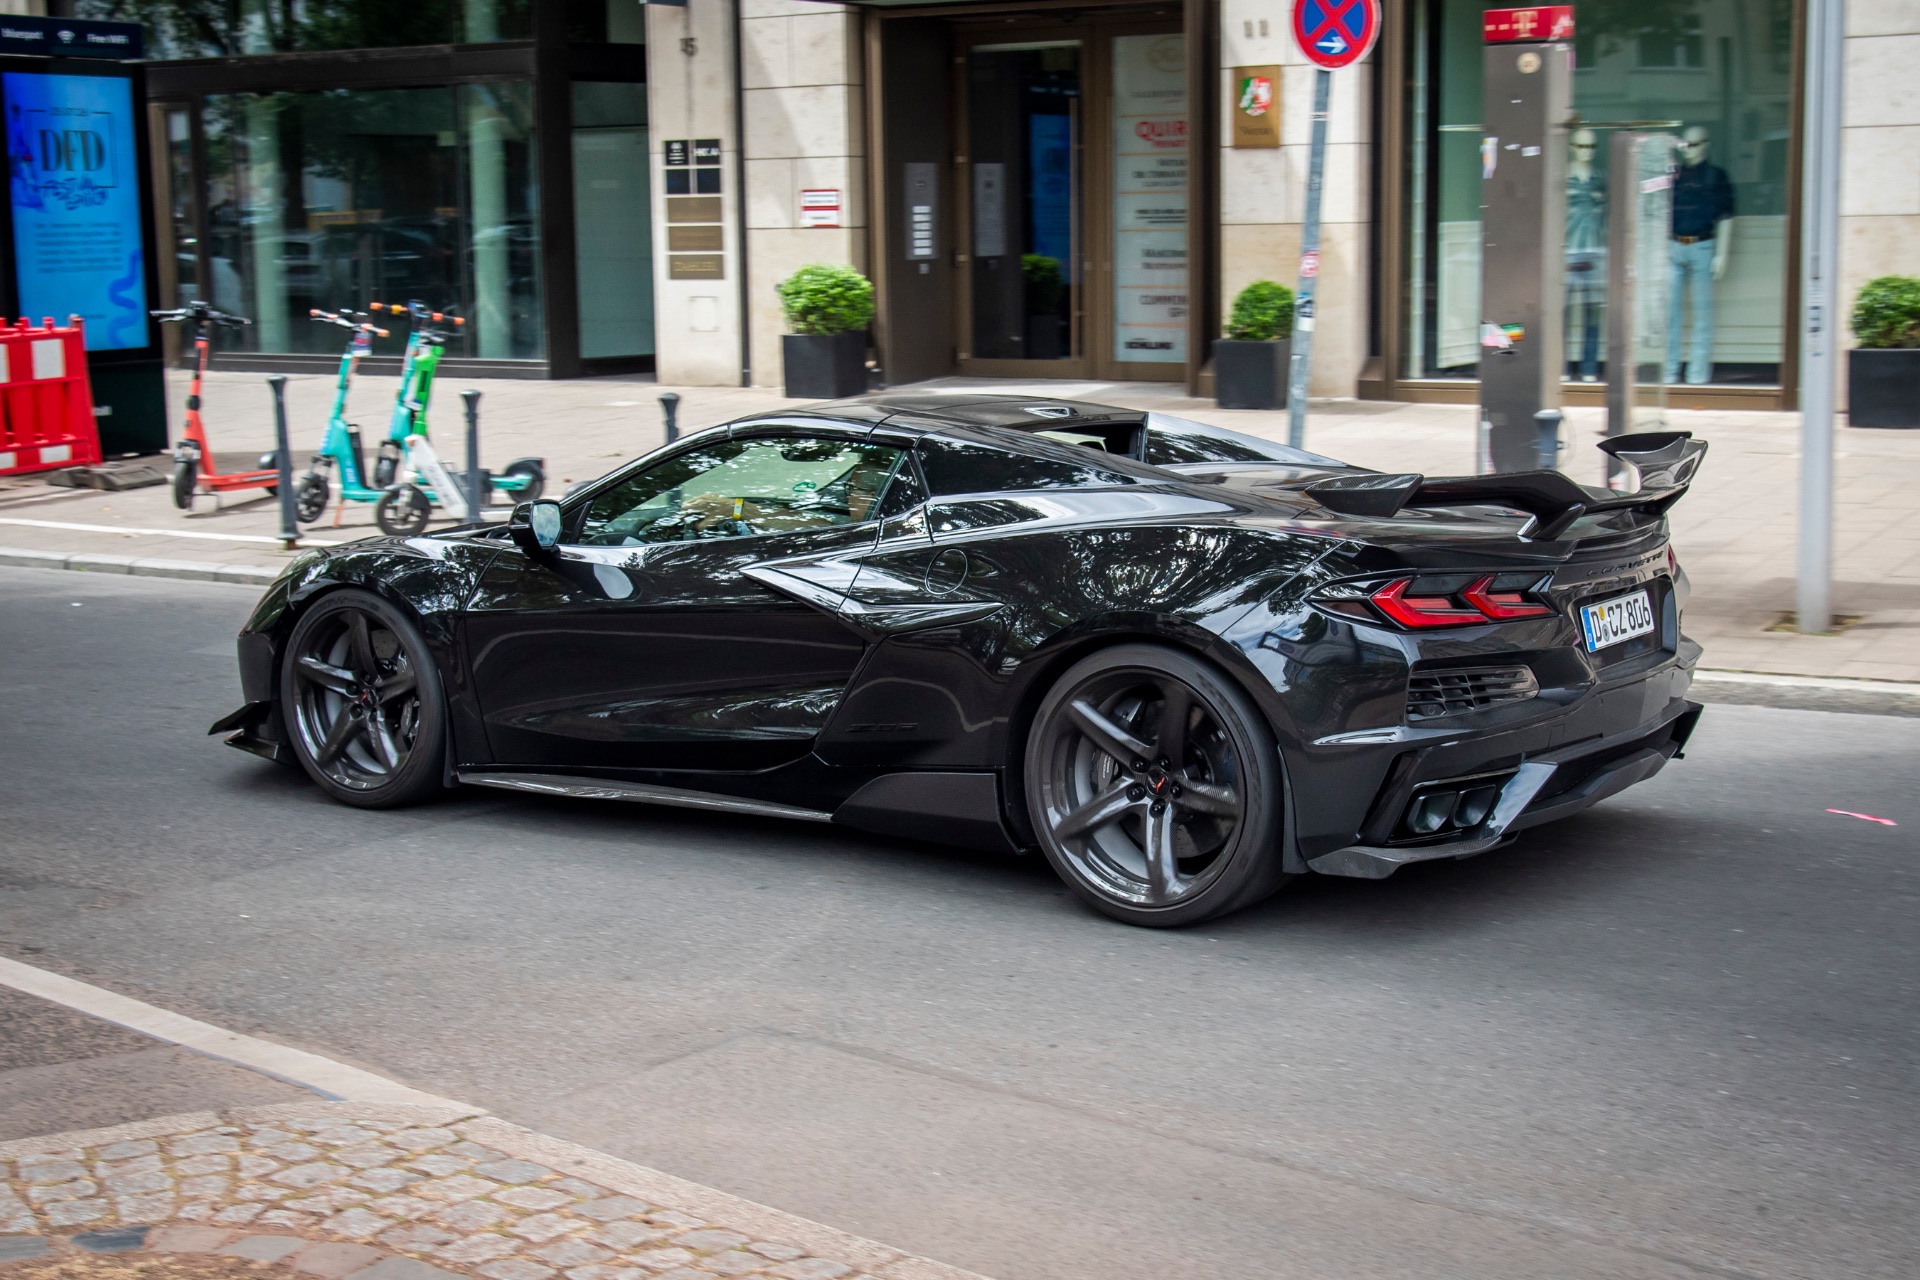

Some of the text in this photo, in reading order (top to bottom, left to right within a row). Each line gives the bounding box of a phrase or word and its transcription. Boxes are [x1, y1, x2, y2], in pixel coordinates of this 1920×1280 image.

[39, 129, 104, 172] DFD
[1590, 596, 1651, 642] D CZ 806
